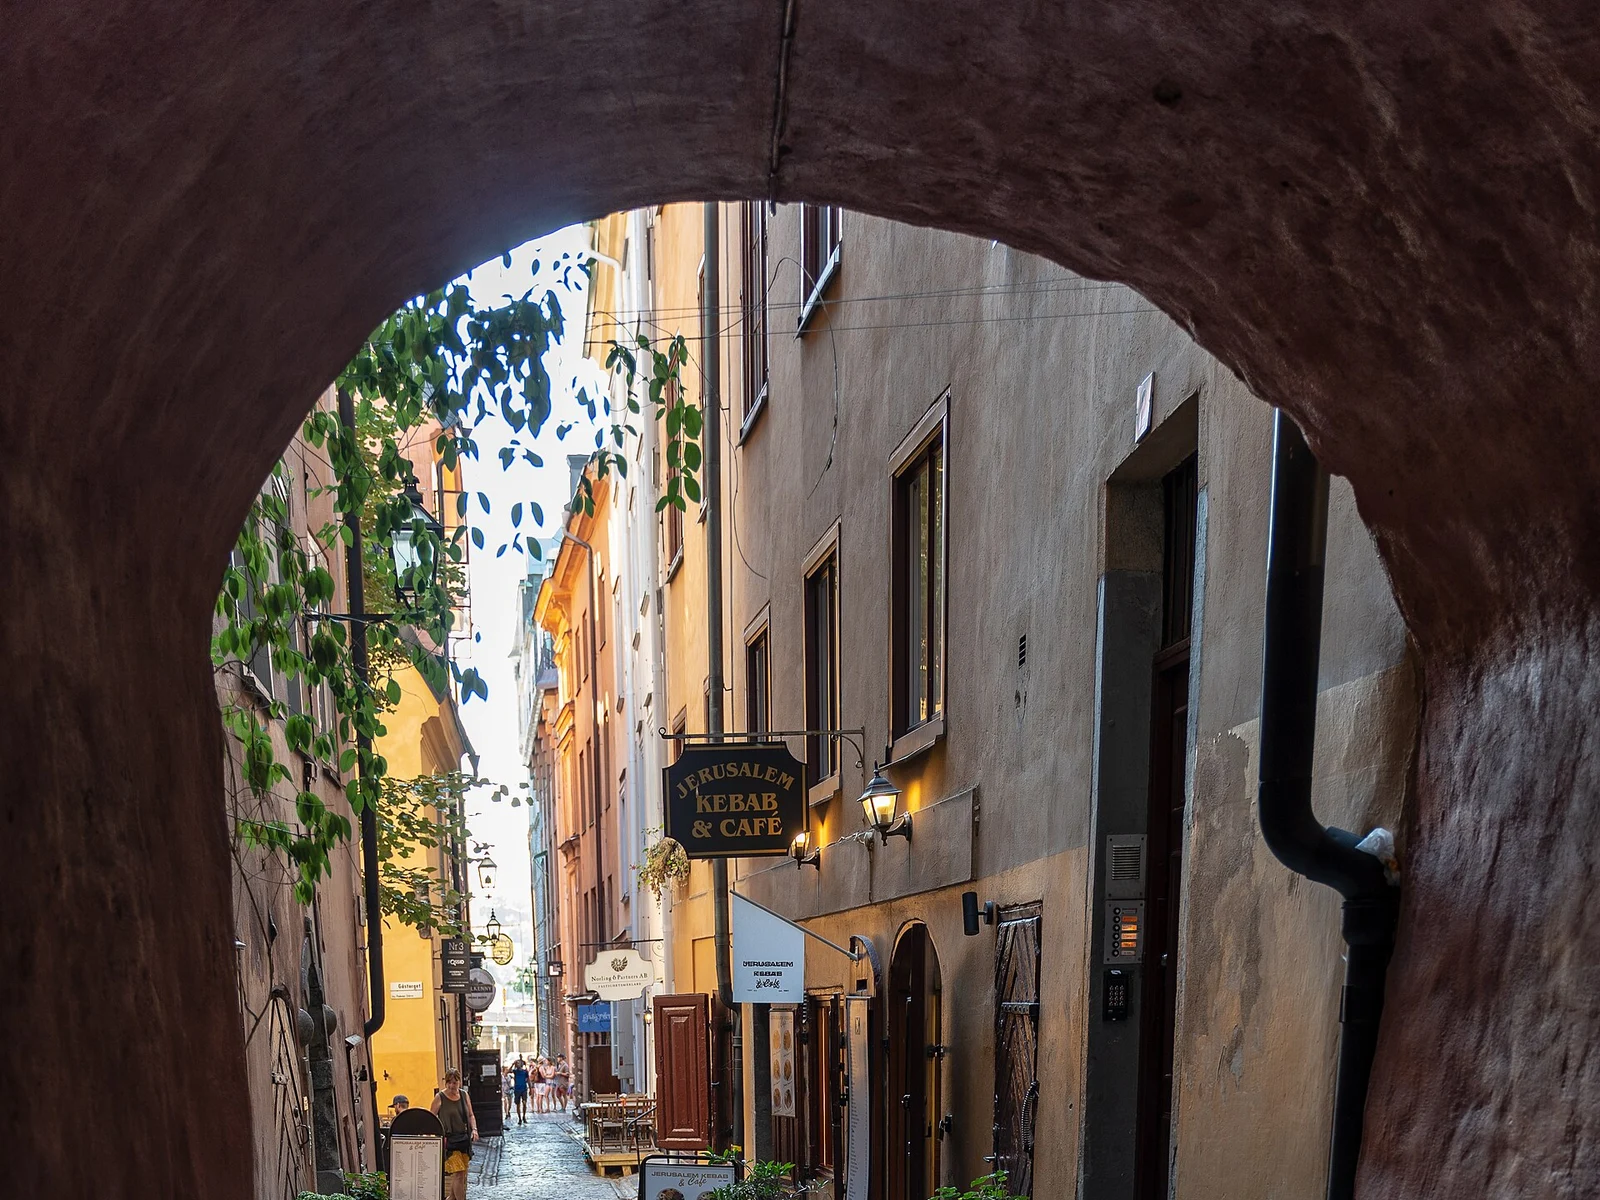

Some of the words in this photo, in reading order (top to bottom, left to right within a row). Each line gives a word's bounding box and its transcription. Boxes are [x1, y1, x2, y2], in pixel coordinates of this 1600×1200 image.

[676, 762, 795, 799] JERUSALEM
[695, 792, 778, 813] KEBAB
[691, 820, 713, 838] &
[719, 810, 783, 837] CAFÉ
[448, 942, 457, 951] Nr
[458, 942, 464, 951] 3
[742, 960, 794, 968] JERUSALEM
[617, 973, 639, 981] Partners
[678, 1179, 685, 1187] &
